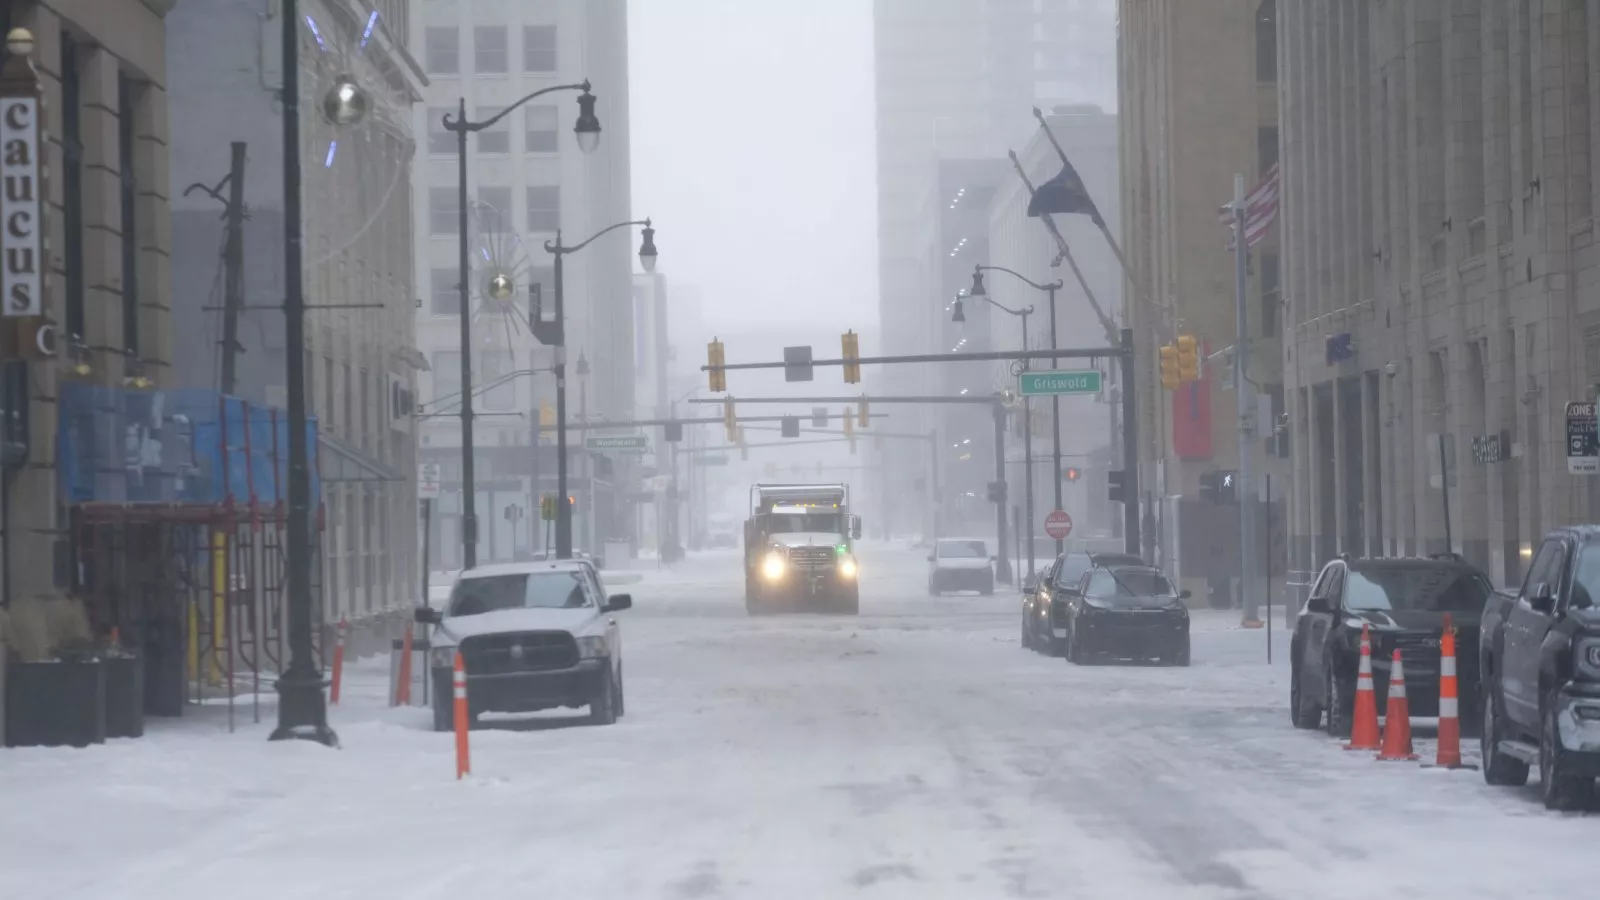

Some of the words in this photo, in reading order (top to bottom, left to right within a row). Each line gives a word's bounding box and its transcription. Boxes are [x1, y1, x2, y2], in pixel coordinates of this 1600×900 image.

[5, 103, 35, 312] caucus
[1034, 376, 1087, 389] Griswold
[1568, 404, 1591, 416] ZONE
